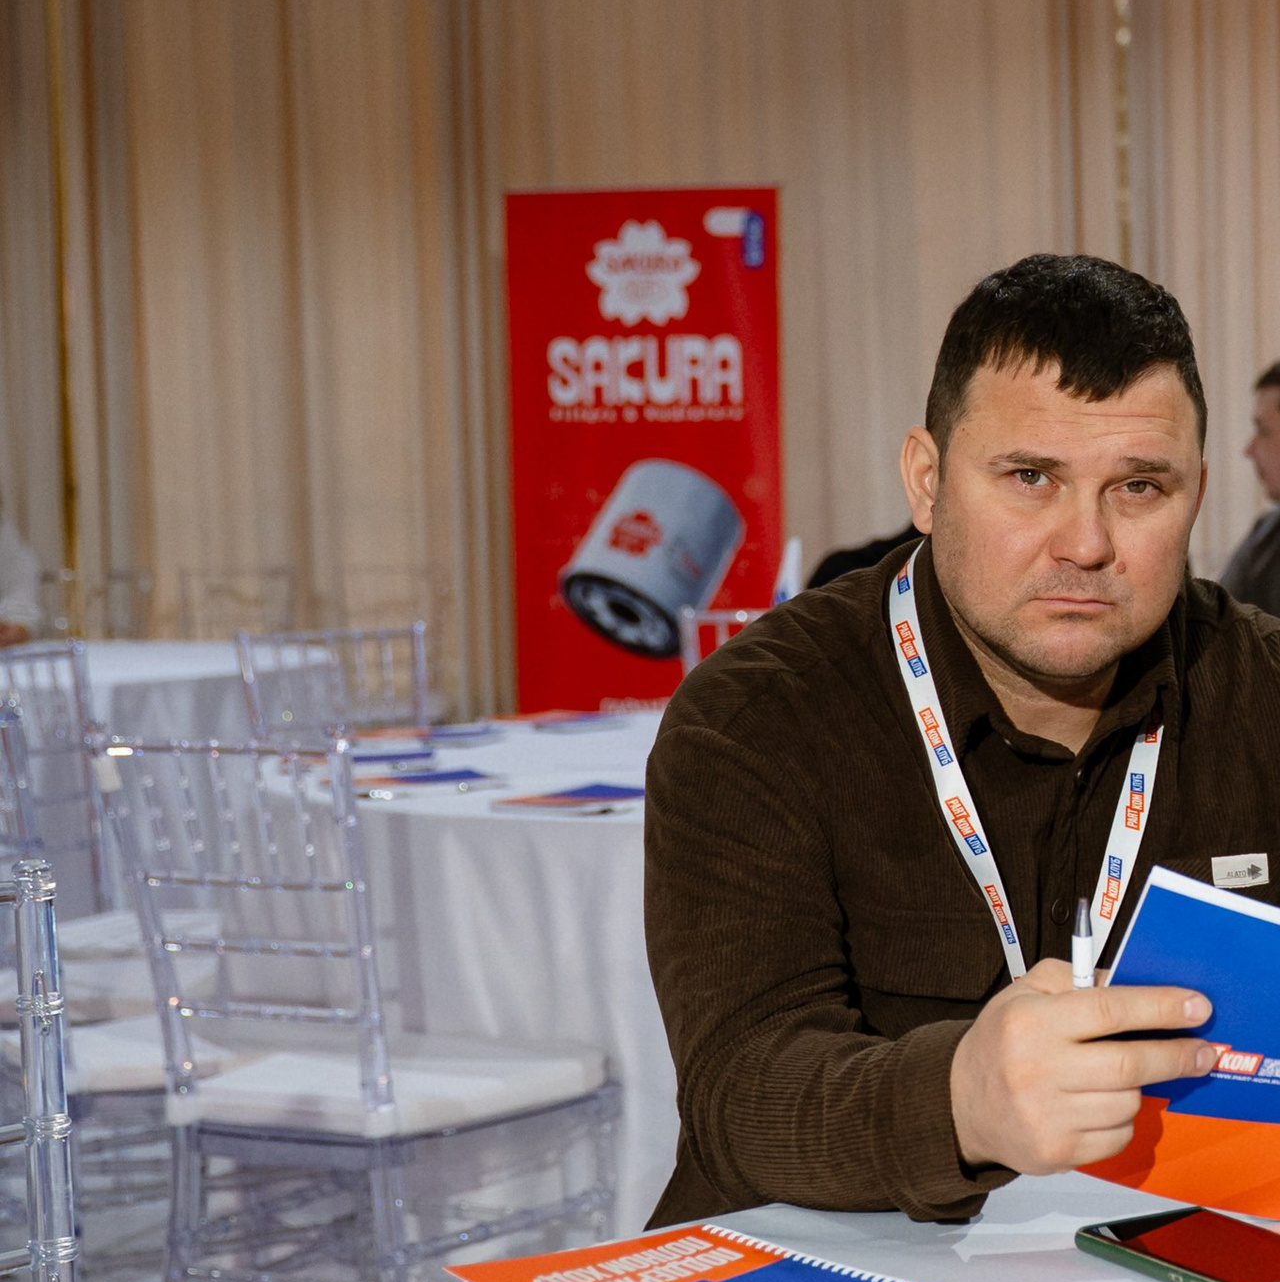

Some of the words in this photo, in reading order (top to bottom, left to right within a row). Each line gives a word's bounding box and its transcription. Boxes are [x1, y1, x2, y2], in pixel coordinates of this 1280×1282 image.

[547, 333, 744, 407] SAKURA
[922, 709, 938, 729] PART
[935, 745, 952, 766] КЛУБ
[1132, 773, 1144, 792] КЛУБ
[949, 799, 968, 818] PART
[967, 835, 986, 855] КЛУБ
[1127, 808, 1139, 830] PART
[1101, 894, 1114, 917] PART
[1110, 856, 1122, 879] КЛУБ
[1218, 1053, 1259, 1073] KOM
[596, 1235, 715, 1277] ПОЛНОМ
